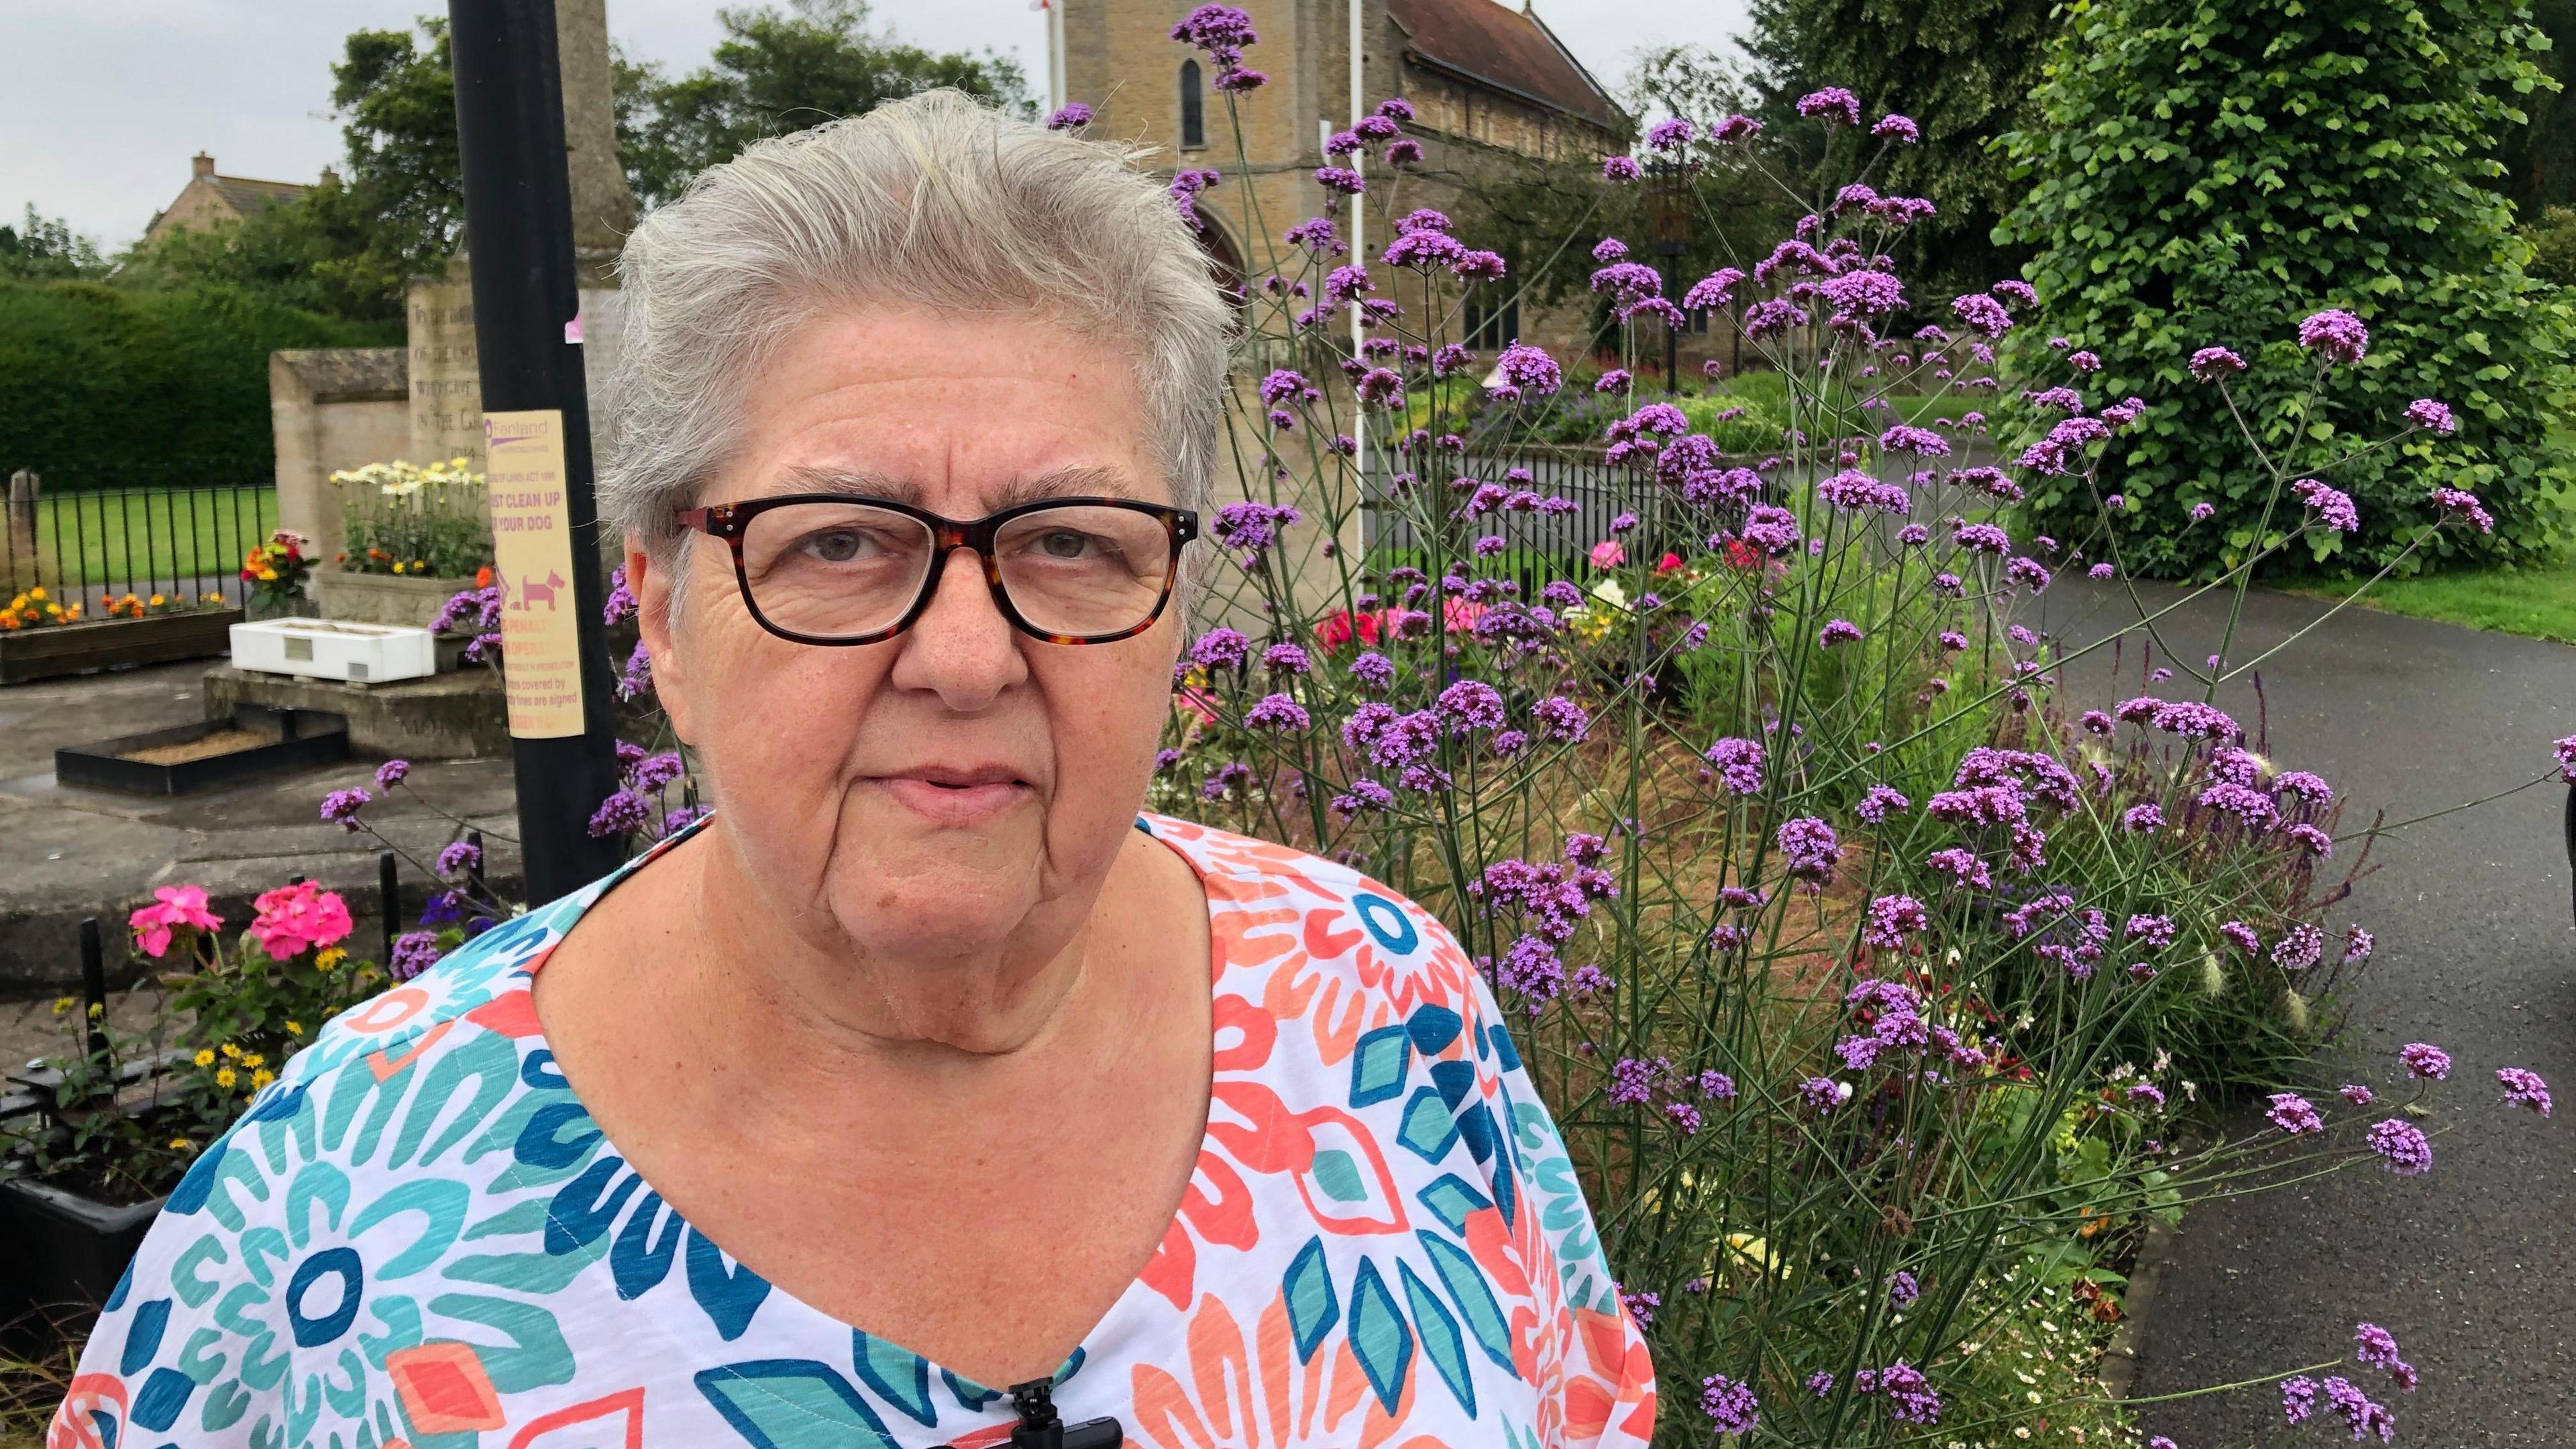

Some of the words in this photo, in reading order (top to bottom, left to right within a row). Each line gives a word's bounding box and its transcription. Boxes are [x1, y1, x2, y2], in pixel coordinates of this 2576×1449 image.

[494, 420, 548, 436] Fenland
[526, 472, 539, 482] ACT
[490, 494, 503, 508] UST
[506, 493, 541, 508] CLEAN
[545, 491, 561, 507] UP
[498, 517, 524, 532] YOUR
[527, 515, 553, 531] DOG
[522, 678, 553, 690] covered
[555, 677, 566, 691] by
[534, 695, 547, 706] are
[549, 691, 578, 708] signed
